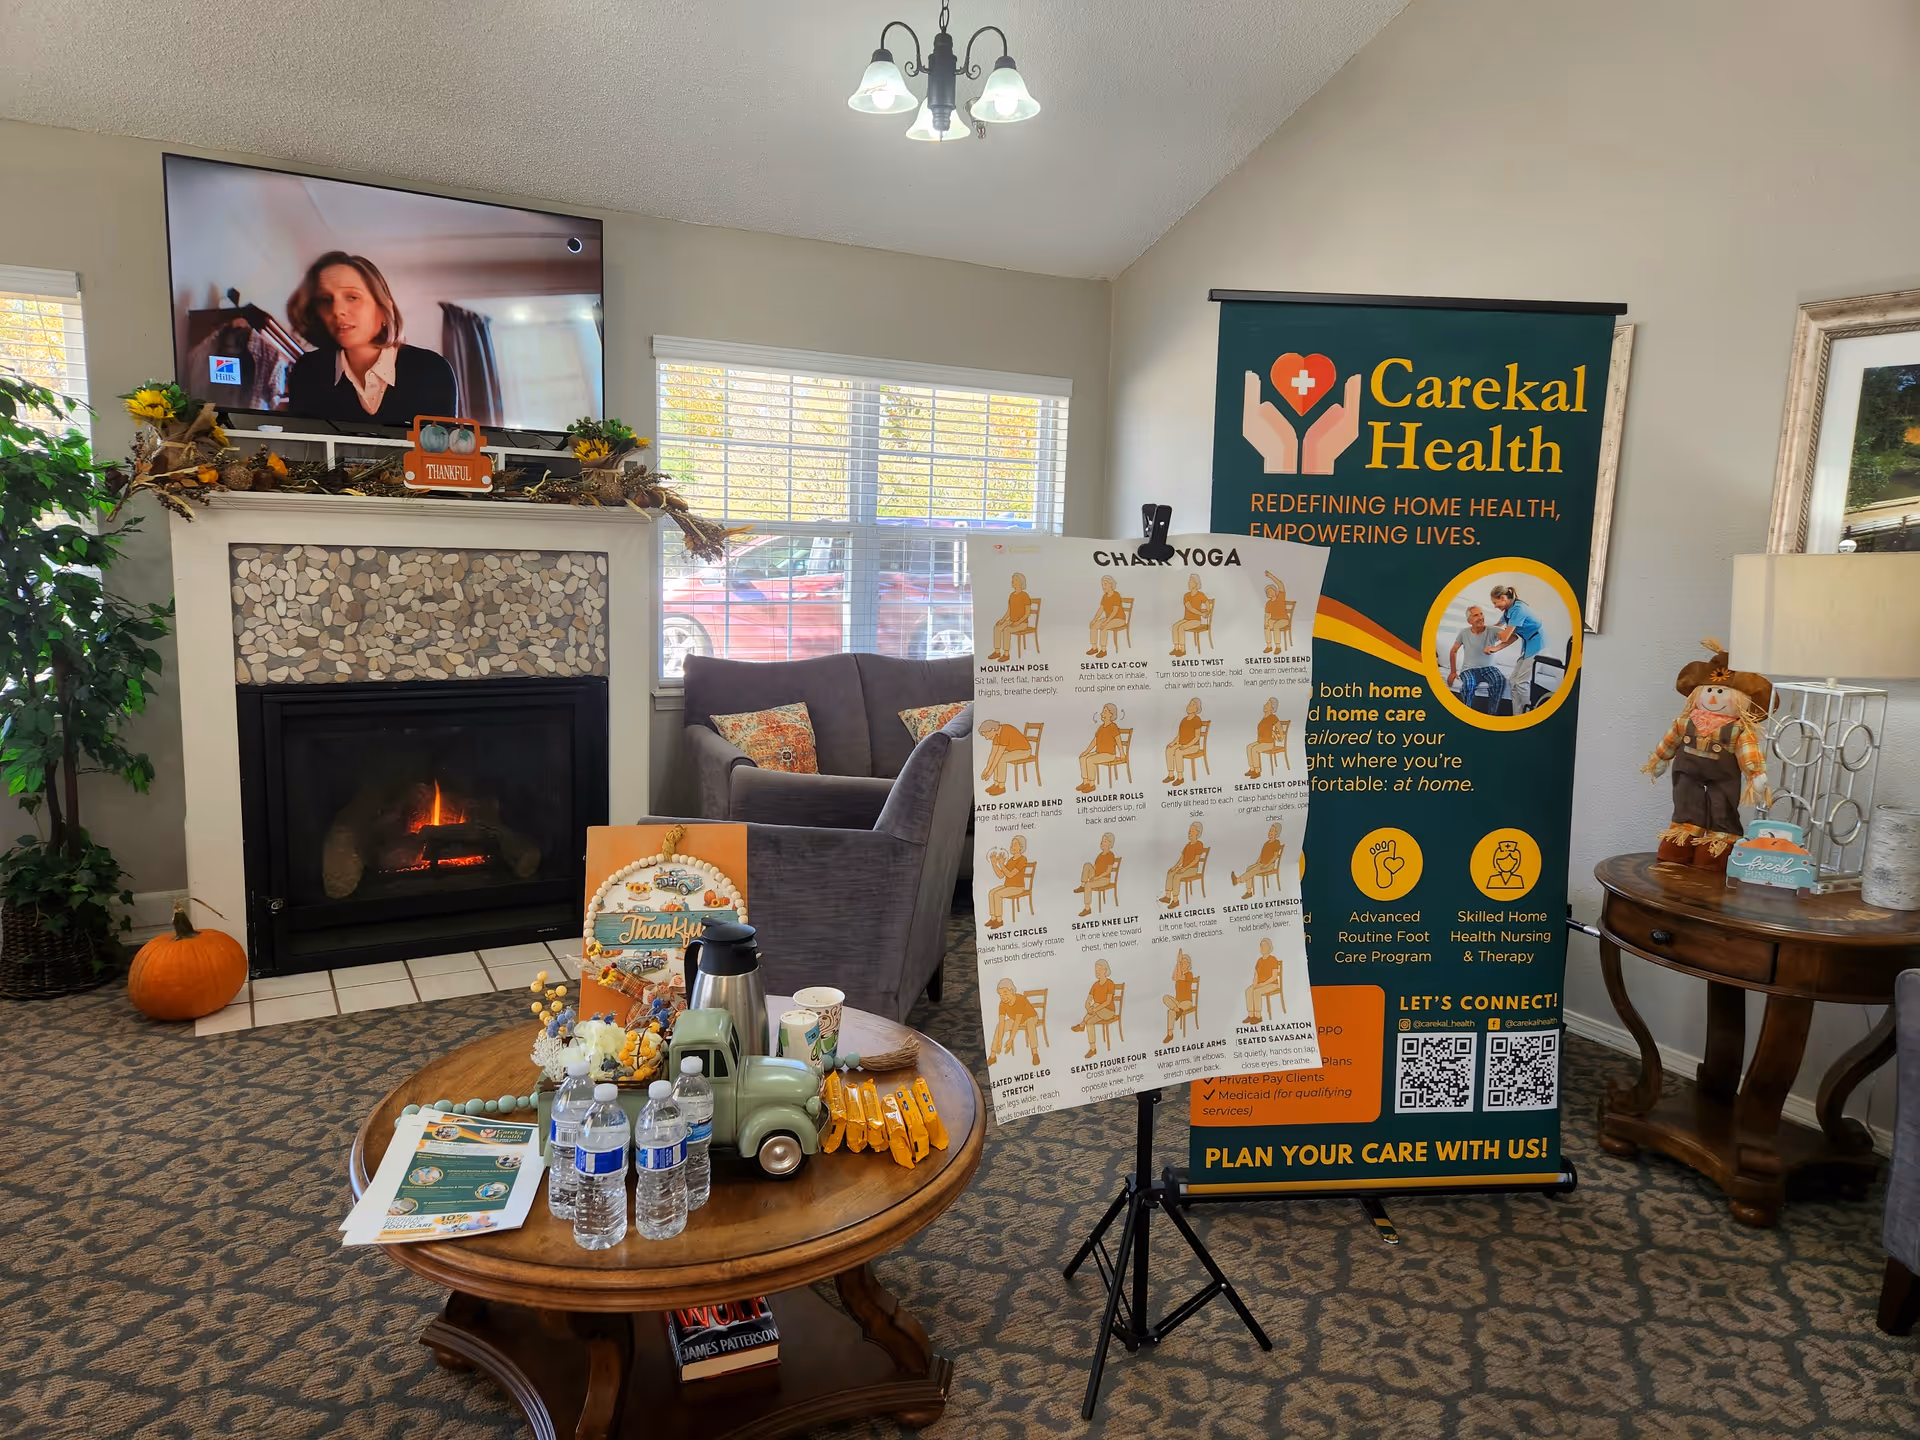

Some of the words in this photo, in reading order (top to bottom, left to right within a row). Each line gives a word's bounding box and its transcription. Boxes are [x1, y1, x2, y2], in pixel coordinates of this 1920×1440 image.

[1371, 357, 1588, 413] Carekal
[1365, 421, 1563, 474] Health
[426, 464, 471, 481] THANKFUL
[1251, 493, 1386, 515] REDEFINING
[1395, 496, 1461, 517] HOME
[1470, 498, 1561, 521] HEALTH,
[1250, 522, 1408, 544] EMPOWERING
[1416, 525, 1481, 546] LIVES.
[1092, 550, 1172, 566] CHA
[1176, 548, 1241, 566] YOGA
[1080, 662, 1109, 670] SEATED
[1172, 659, 1199, 667] SEATED
[1201, 658, 1224, 666] TWIST
[1245, 657, 1272, 665] SEATED
[1273, 656, 1290, 664] SIDE
[980, 664, 1025, 672] MOUNTAIN
[1027, 663, 1049, 671] POSE
[1156, 671, 1170, 679] Turn
[1190, 670, 1197, 678] to
[1228, 668, 1243, 676] hold
[1249, 667, 1262, 675] One
[975, 676, 985, 685] Sit
[1001, 676, 1014, 684] feet
[1031, 675, 1053, 683] hands
[1079, 673, 1094, 681] Arch
[1097, 672, 1113, 680] back
[1244, 678, 1257, 686] lean
[1259, 677, 1278, 686] gently
[1004, 687, 1032, 696] breathe
[1075, 684, 1095, 693] round
[1097, 684, 1116, 693] spine
[1164, 682, 1180, 690] chair
[1182, 681, 1196, 689] with
[1320, 682, 1362, 698] both
[1369, 682, 1422, 698] home
[1326, 706, 1378, 722] home
[1385, 709, 1426, 722] care
[1377, 730, 1396, 745] to
[1402, 733, 1445, 748] your
[1341, 753, 1397, 768] where
[1404, 753, 1462, 771] you’re
[1234, 783, 1261, 791] SEATED
[1263, 781, 1285, 789] CHEST
[1393, 778, 1411, 792] at
[1418, 776, 1475, 792] home.
[1076, 794, 1118, 804] SHOULDER
[1120, 792, 1144, 801] ROLLS
[1167, 789, 1188, 797] NECK
[1189, 786, 1222, 796] STRETCH
[974, 803, 997, 812] ATED
[999, 800, 1040, 810] FORWARD
[1041, 799, 1063, 807] BEND
[1159, 911, 1183, 921] ANKLE
[1184, 907, 1216, 918] CIRCLES
[1222, 904, 1248, 913] SEATED
[1251, 902, 1264, 910] LEG
[1350, 910, 1420, 923] Advanced
[1457, 910, 1504, 922] Skilled
[1509, 910, 1547, 922] Home
[1071, 921, 1100, 931] SEATED
[1102, 918, 1121, 927] KNEE
[1124, 916, 1139, 924] LIFT
[618, 914, 708, 948] Thankfu
[987, 931, 1012, 941] WRIST
[1014, 927, 1048, 937] CIRCLES
[1338, 931, 1392, 943] Routine
[1397, 931, 1430, 942] Foot
[1451, 930, 1496, 942] Health
[1500, 930, 1551, 944] Nursing
[1335, 951, 1367, 963] Care
[1371, 951, 1431, 965] Program
[1463, 951, 1474, 963] &
[1479, 951, 1534, 964] Therapy
[1400, 995, 1452, 1011] LET’S
[1460, 992, 1558, 1010] CONNECT!
[1236, 1026, 1259, 1035] FINAL
[1261, 1022, 1312, 1032] RELAXATION
[1318, 1026, 1343, 1036] PPO
[1154, 1046, 1180, 1057] SEATED
[1182, 1043, 1204, 1052] EAGLE
[1206, 1039, 1227, 1048] ARMS
[1233, 1051, 1243, 1059] Sit
[1270, 1047, 1291, 1056] hands
[1070, 1062, 1099, 1074] SEATED
[1100, 1056, 1126, 1068] FIGURE
[1127, 1053, 1147, 1062] FOUR
[1241, 1061, 1259, 1069] close
[1322, 1056, 1353, 1066] Plans
[1219, 1075, 1259, 1085] Private
[1263, 1074, 1283, 1086] Pay
[1286, 1073, 1325, 1083] Clients
[1002, 1084, 1034, 1098] STRETCH
[1218, 1090, 1271, 1100] Medicaid
[1273, 1089, 1293, 1100] (for
[1295, 1088, 1352, 1099] qualifying
[1203, 1105, 1253, 1117] services)
[1205, 1146, 1273, 1169] PLAN
[1280, 1144, 1354, 1167] YOUR
[1361, 1142, 1427, 1165] CARE
[1436, 1140, 1500, 1162] WITH
[1508, 1137, 1547, 1160] US!
[440, 1213, 469, 1222] 10%
[683, 1341, 719, 1361] JAMES
[719, 1328, 779, 1352] PATTERSON
